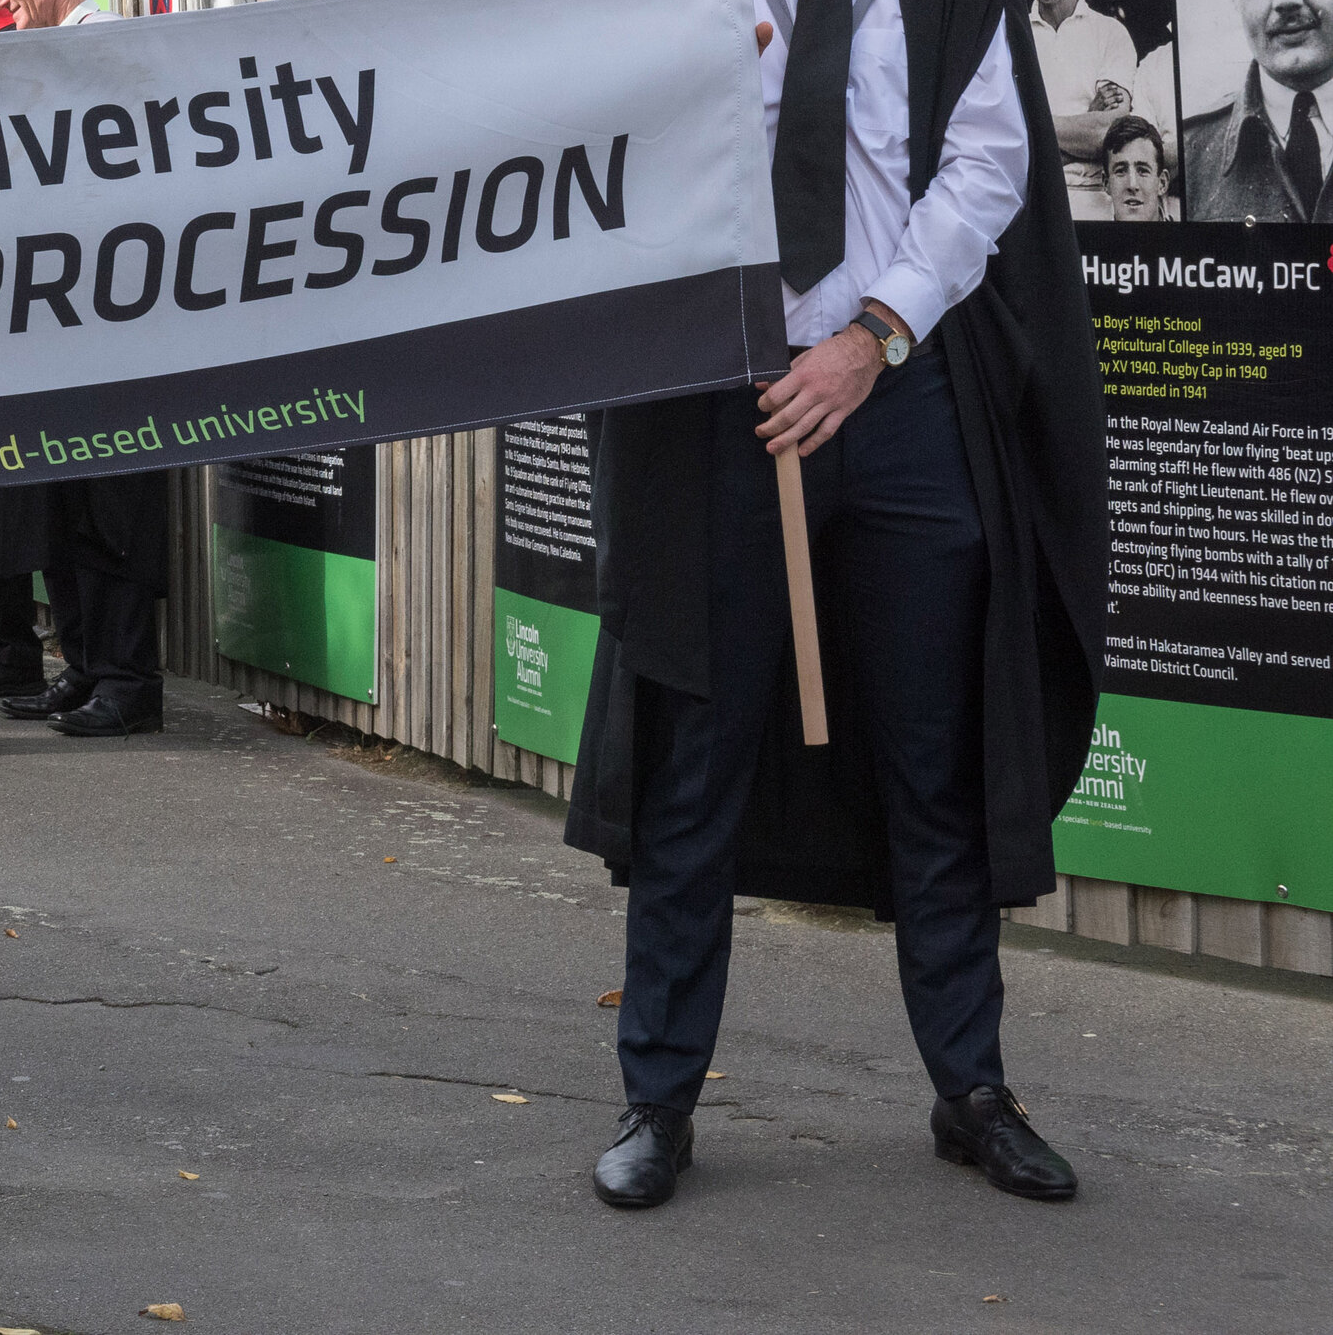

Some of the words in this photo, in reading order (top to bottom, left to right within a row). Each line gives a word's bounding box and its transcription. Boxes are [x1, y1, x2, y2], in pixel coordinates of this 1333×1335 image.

[1082, 256, 1149, 293] Hugh
[1159, 257, 1263, 294] McCaw,
[1274, 263, 1320, 290] DFC
[1105, 316, 1132, 331] Boys'
[1136, 317, 1160, 333] High
[1164, 318, 1200, 331] School
[1103, 338, 1165, 353] Agricultural
[1169, 340, 1209, 357] College
[1213, 342, 1222, 354] in
[1226, 343, 1255, 357] 1939,
[1259, 344, 1286, 360] aged
[1290, 345, 1302, 357] 19
[1113, 360, 1127, 372] XV
[1131, 361, 1159, 374] 1940.
[1163, 362, 1198, 379] Rugby
[1202, 364, 1222, 379] Cap
[1226, 365, 1236, 377] in
[1240, 366, 1266, 379] 1940
[1121, 384, 1166, 396] awarded
[1170, 385, 1179, 397] in
[1183, 386, 1206, 398] 1941
[171, 387, 365, 446] university
[1108, 415, 1117, 428] in
[1120, 416, 1138, 429] the
[1142, 417, 1171, 434] Royal
[1175, 419, 1199, 432] New
[1203, 421, 1248, 435] Zealand
[1252, 423, 1269, 436] Air
[1273, 424, 1304, 438] Force
[1308, 426, 1318, 439] in
[1106, 436, 1120, 449] He
[1123, 440, 1143, 450] was
[1147, 438, 1201, 457] legendary
[1204, 441, 1220, 454] for
[1223, 443, 1243, 456] low
[1246, 444, 1279, 462] flying
[1110, 457, 1156, 475] alarming
[1160, 460, 1189, 474] staff!
[1193, 462, 1208, 475] He
[1211, 463, 1236, 477] flew
[1239, 466, 1265, 479] with
[1268, 467, 1291, 481] 486
[1295, 468, 1321, 484] (NZ)
[1125, 479, 1148, 492] rank
[1151, 480, 1162, 493] of
[1166, 481, 1197, 498] Flight
[1201, 484, 1267, 500] Lieutenant.
[1271, 489, 1287, 502] He
[1290, 489, 1316, 504] flew
[1141, 501, 1160, 514] and
[1164, 502, 1214, 521] shipping,
[1218, 506, 1231, 519] he
[1235, 510, 1257, 521] was
[1261, 509, 1299, 524] skilled
[1303, 512, 1313, 525] in
[1118, 519, 1146, 533] down
[1150, 521, 1172, 535] four
[1175, 523, 1185, 536] in
[1188, 526, 1209, 539] two
[1213, 526, 1248, 541] hours.
[1252, 530, 1267, 543] He
[1271, 534, 1294, 545] was
[1298, 533, 1317, 547] the
[1112, 539, 1167, 559] destroying
[1171, 544, 1202, 562] flying
[1205, 547, 1243, 562] bombs
[1247, 551, 1273, 565] with
[1277, 556, 1283, 565] a
[1286, 554, 1313, 571] tally
[1316, 556, 1328, 569] of
[1114, 560, 1142, 574] Cross
[1146, 562, 1174, 579] (DFC)
[1178, 566, 1188, 578] in
[1191, 568, 1218, 581] 1944
[1221, 570, 1246, 584] with
[1250, 572, 1267, 585] his
[1270, 574, 1316, 589] citation
[1143, 584, 1176, 601] ability
[1180, 588, 1200, 601] and
[1203, 589, 1257, 606] keenness
[1260, 594, 1288, 609] have
[1292, 596, 1320, 611] been
[515, 618, 540, 645] Lincoln
[516, 639, 549, 674] University
[1107, 636, 1133, 648] rmed
[1137, 637, 1146, 650] in
[1150, 639, 1224, 658] Hakataramea
[1227, 647, 1262, 665] Valley
[1266, 652, 1287, 664] and
[1291, 656, 1330, 668] served
[517, 660, 542, 688] Alumni
[1151, 659, 1190, 675] District
[1194, 664, 1237, 680] Council.
